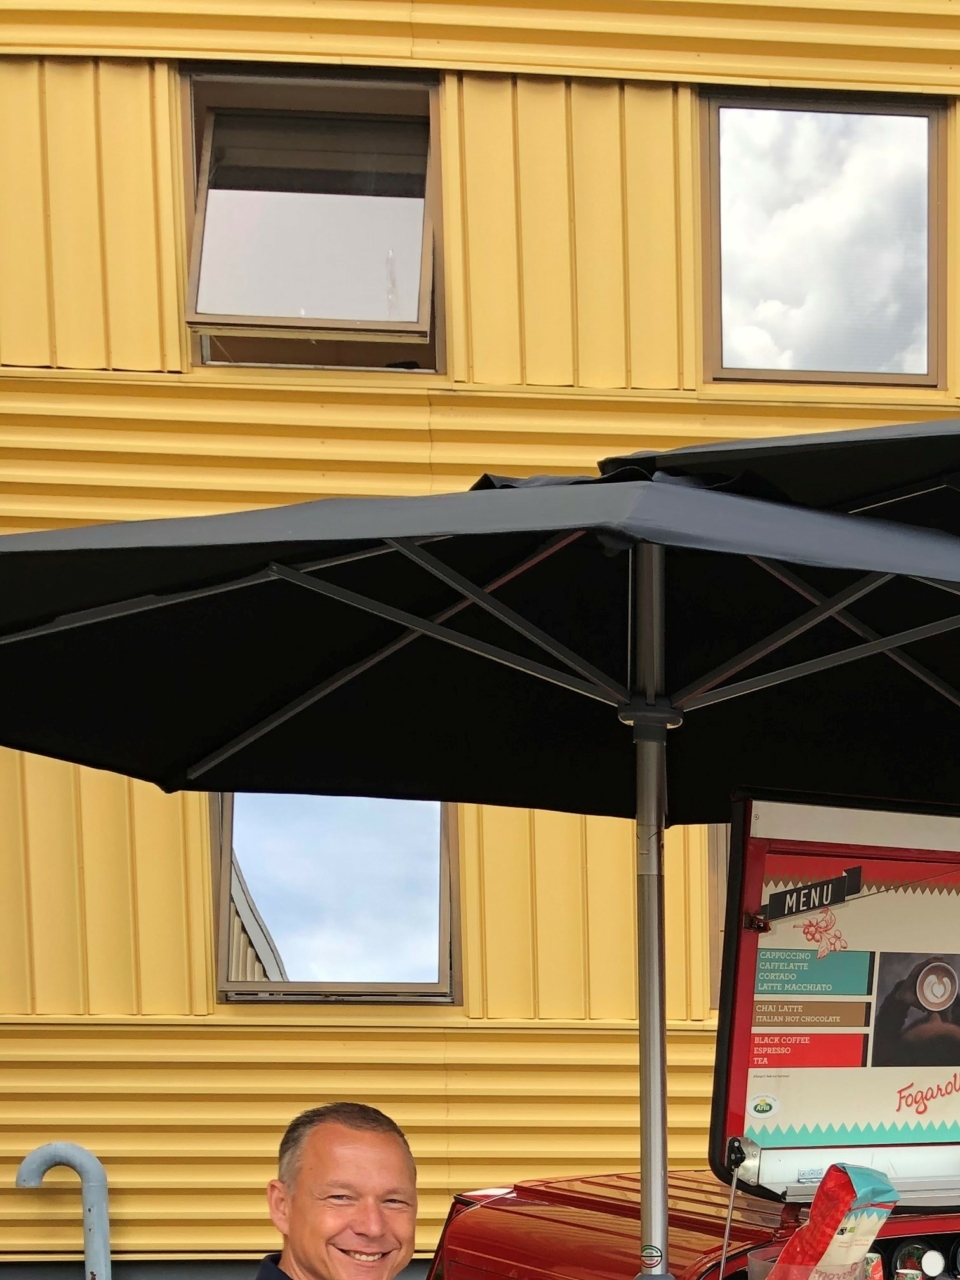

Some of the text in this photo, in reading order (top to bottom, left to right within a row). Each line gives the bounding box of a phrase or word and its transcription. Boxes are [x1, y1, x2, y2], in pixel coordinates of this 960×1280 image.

[784, 883, 832, 915] MENU
[760, 951, 811, 960] CAPPUCCINO
[759, 962, 809, 970] CAFFELATTE
[758, 972, 797, 980] CORTADO
[784, 983, 833, 991] MACCHIATO
